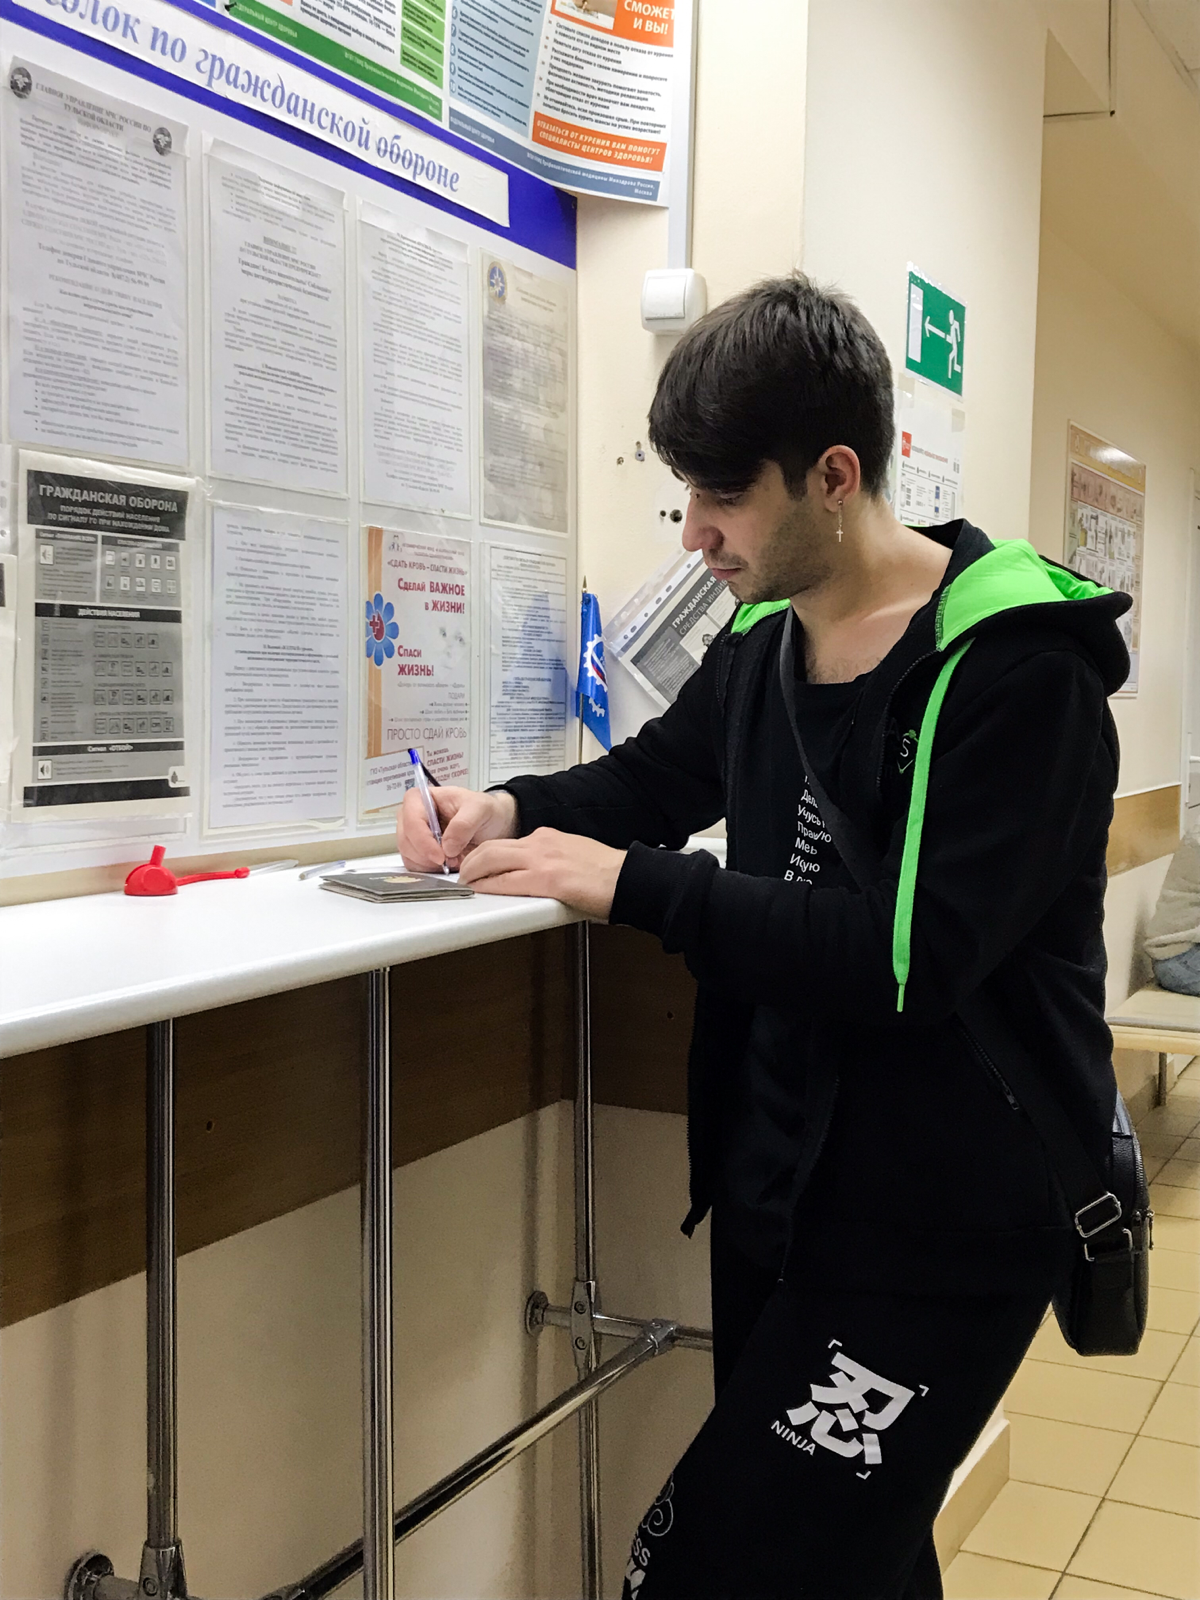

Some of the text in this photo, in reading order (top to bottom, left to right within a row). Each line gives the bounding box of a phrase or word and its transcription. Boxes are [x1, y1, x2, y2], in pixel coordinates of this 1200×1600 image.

[624, 0, 675, 20] СМОЖЕТ
[633, 17, 669, 35] И ВЫ!
[45, 0, 141, 45] олок
[150, 26, 187, 63] по
[195, 48, 371, 151] гражданской
[376, 134, 460, 193] обороне
[570, 131, 579, 139] ОТ
[579, 134, 611, 147] КУРЕНИЯ
[612, 141, 627, 150] ВАМ
[628, 144, 660, 155] ПОМОГУТ
[581, 144, 613, 157] ЦЕНТРОВ
[613, 151, 653, 164] ЗДОРОВЬЯ!
[39, 484, 178, 513] ГРАЖДАНСКАЯ ОБОРОНА
[429, 581, 465, 596] ВАЖНОЕ
[431, 599, 465, 614] ЖИЗНИ!
[672, 575, 717, 628] ГРАЖДАНСКАЯ
[679, 602, 709, 635] СРЕДСТВА
[397, 663, 434, 677] ЖИЗНЬ!
[387, 726, 467, 741] ПРОСТО СДАЙ КРОВЬ
[770, 1420, 816, 1456] NINJA
